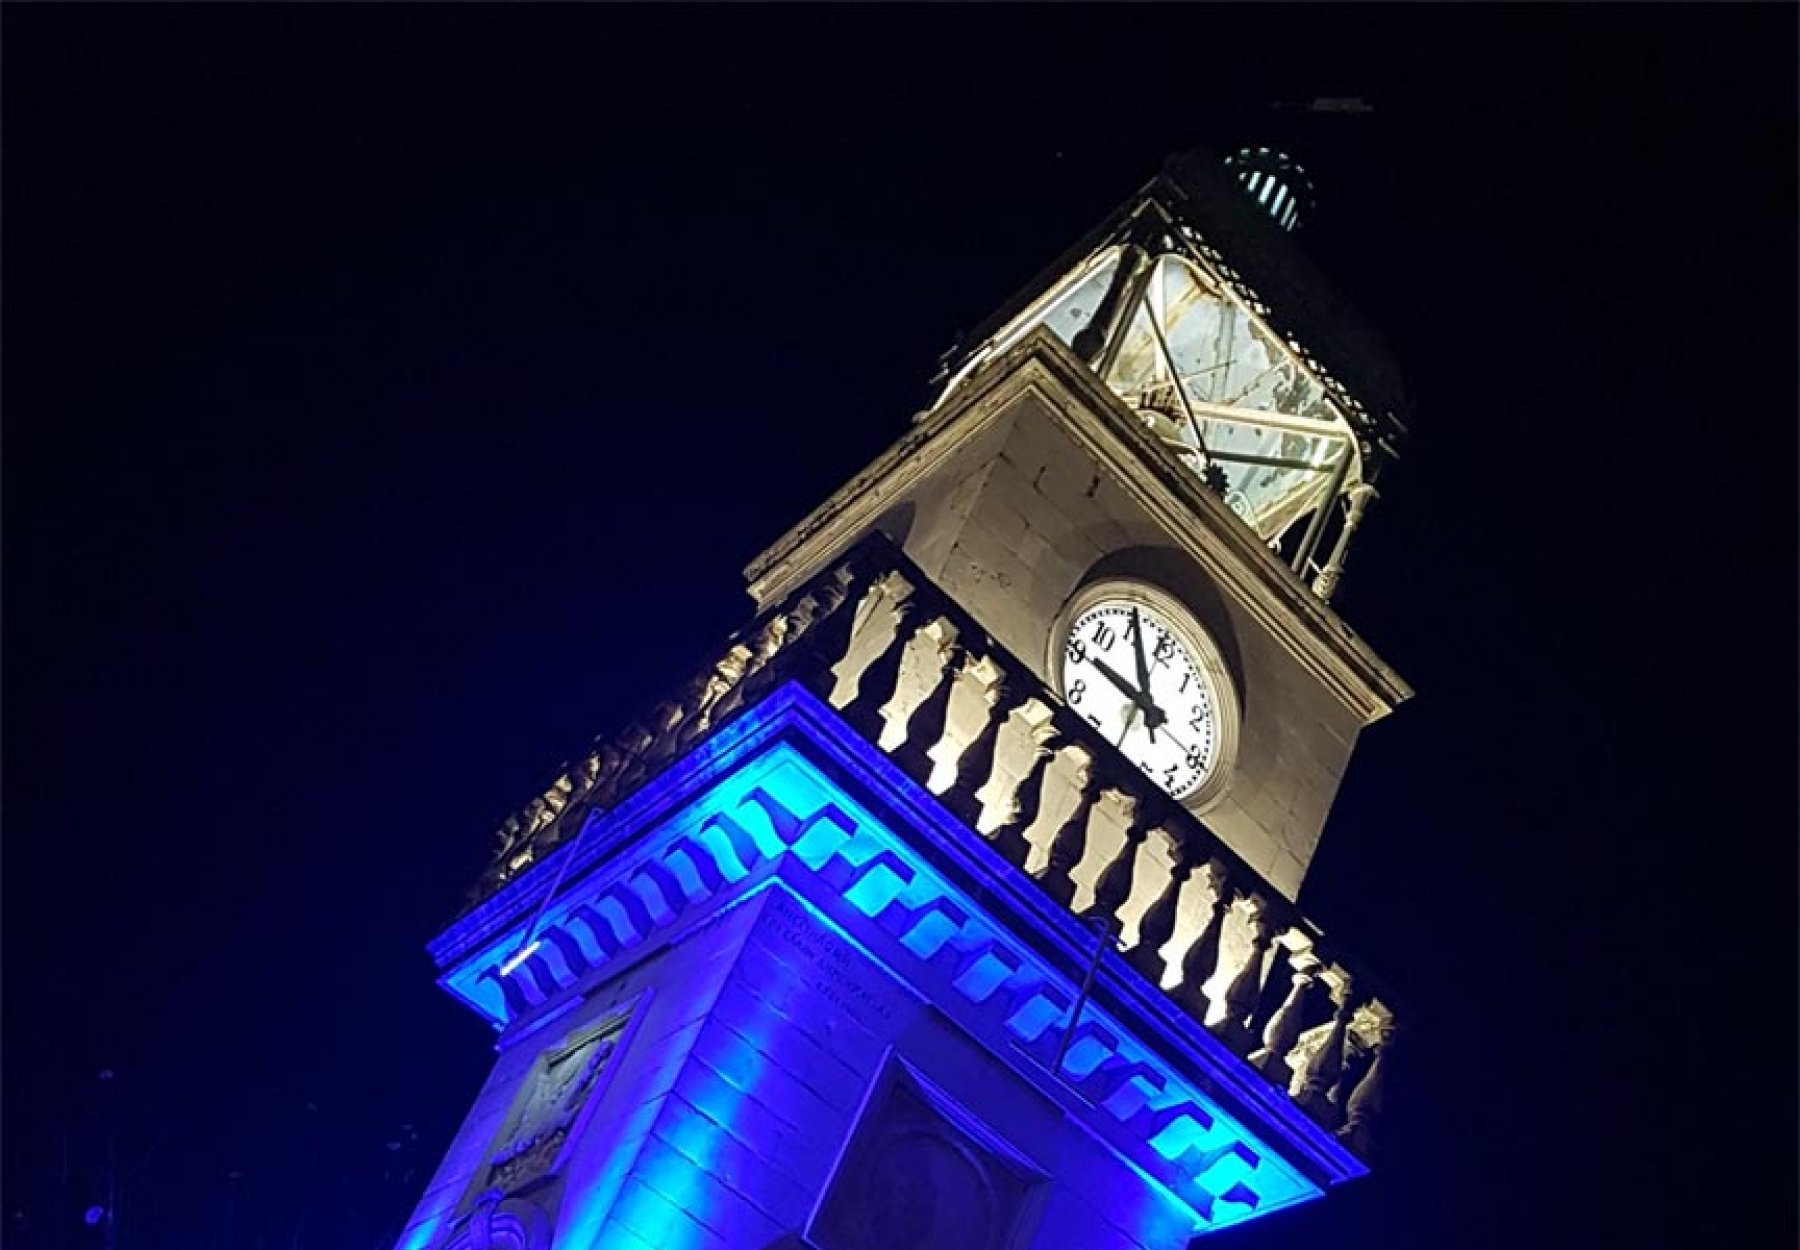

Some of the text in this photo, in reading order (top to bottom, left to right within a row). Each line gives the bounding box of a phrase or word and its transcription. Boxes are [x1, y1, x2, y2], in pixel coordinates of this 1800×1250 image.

[1091, 620, 1115, 652] 10
[1151, 635, 1175, 669] 12
[1068, 679, 1087, 705] 8
[1179, 673, 1190, 694] 1
[1189, 704, 1206, 733] 2
[1185, 743, 1202, 769] 3
